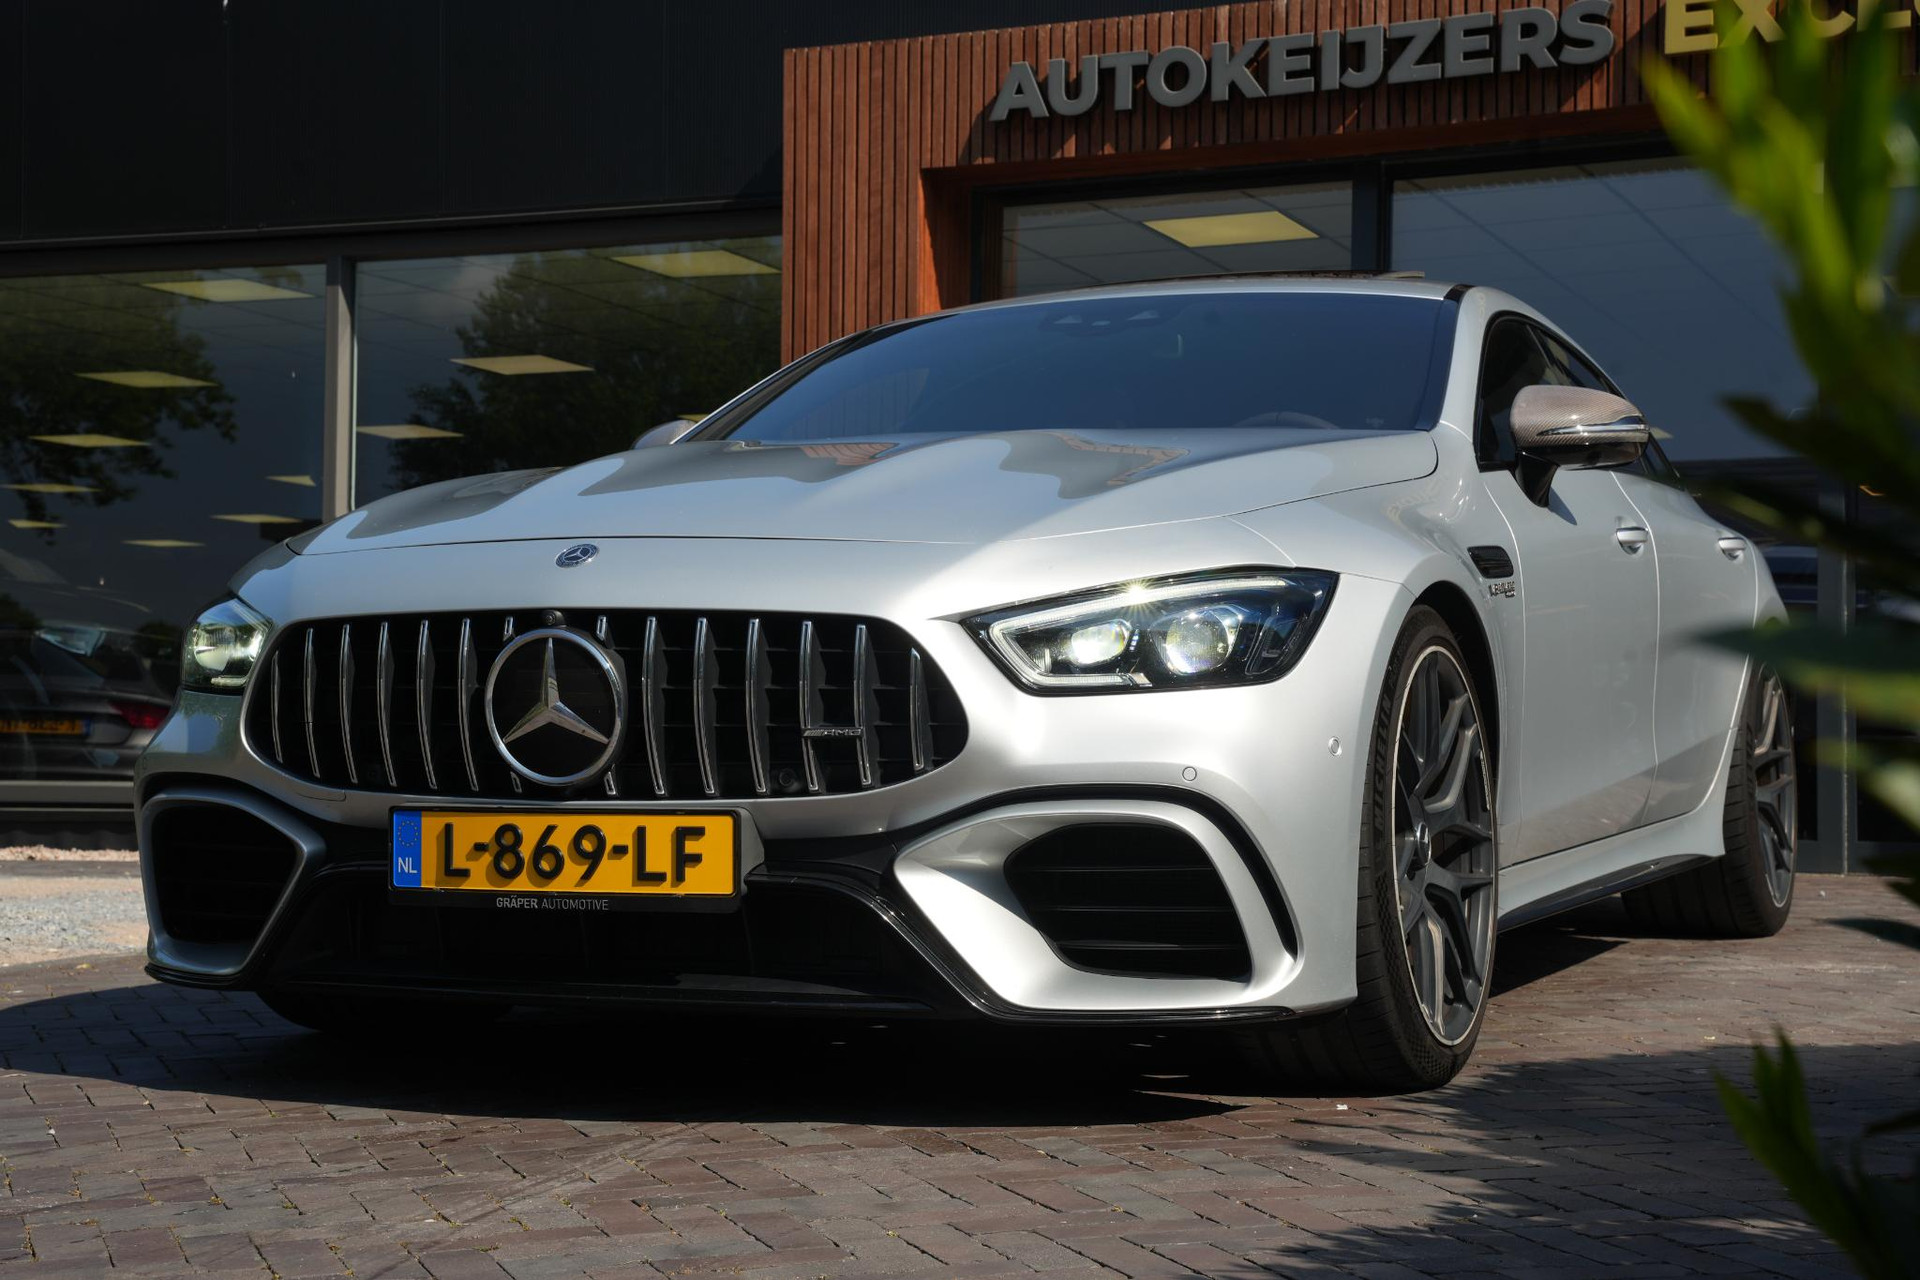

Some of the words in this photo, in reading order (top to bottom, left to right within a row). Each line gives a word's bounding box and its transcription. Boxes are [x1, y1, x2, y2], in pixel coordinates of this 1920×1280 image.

[988, 0, 1614, 122] AUTOKEIJZERS
[1374, 693, 1392, 832] MICHELIN
[398, 857, 418, 874] NL
[443, 822, 706, 883] L-869-LF
[496, 895, 538, 909] GRÄPER
[541, 898, 609, 911] AUTOMOTIVE
